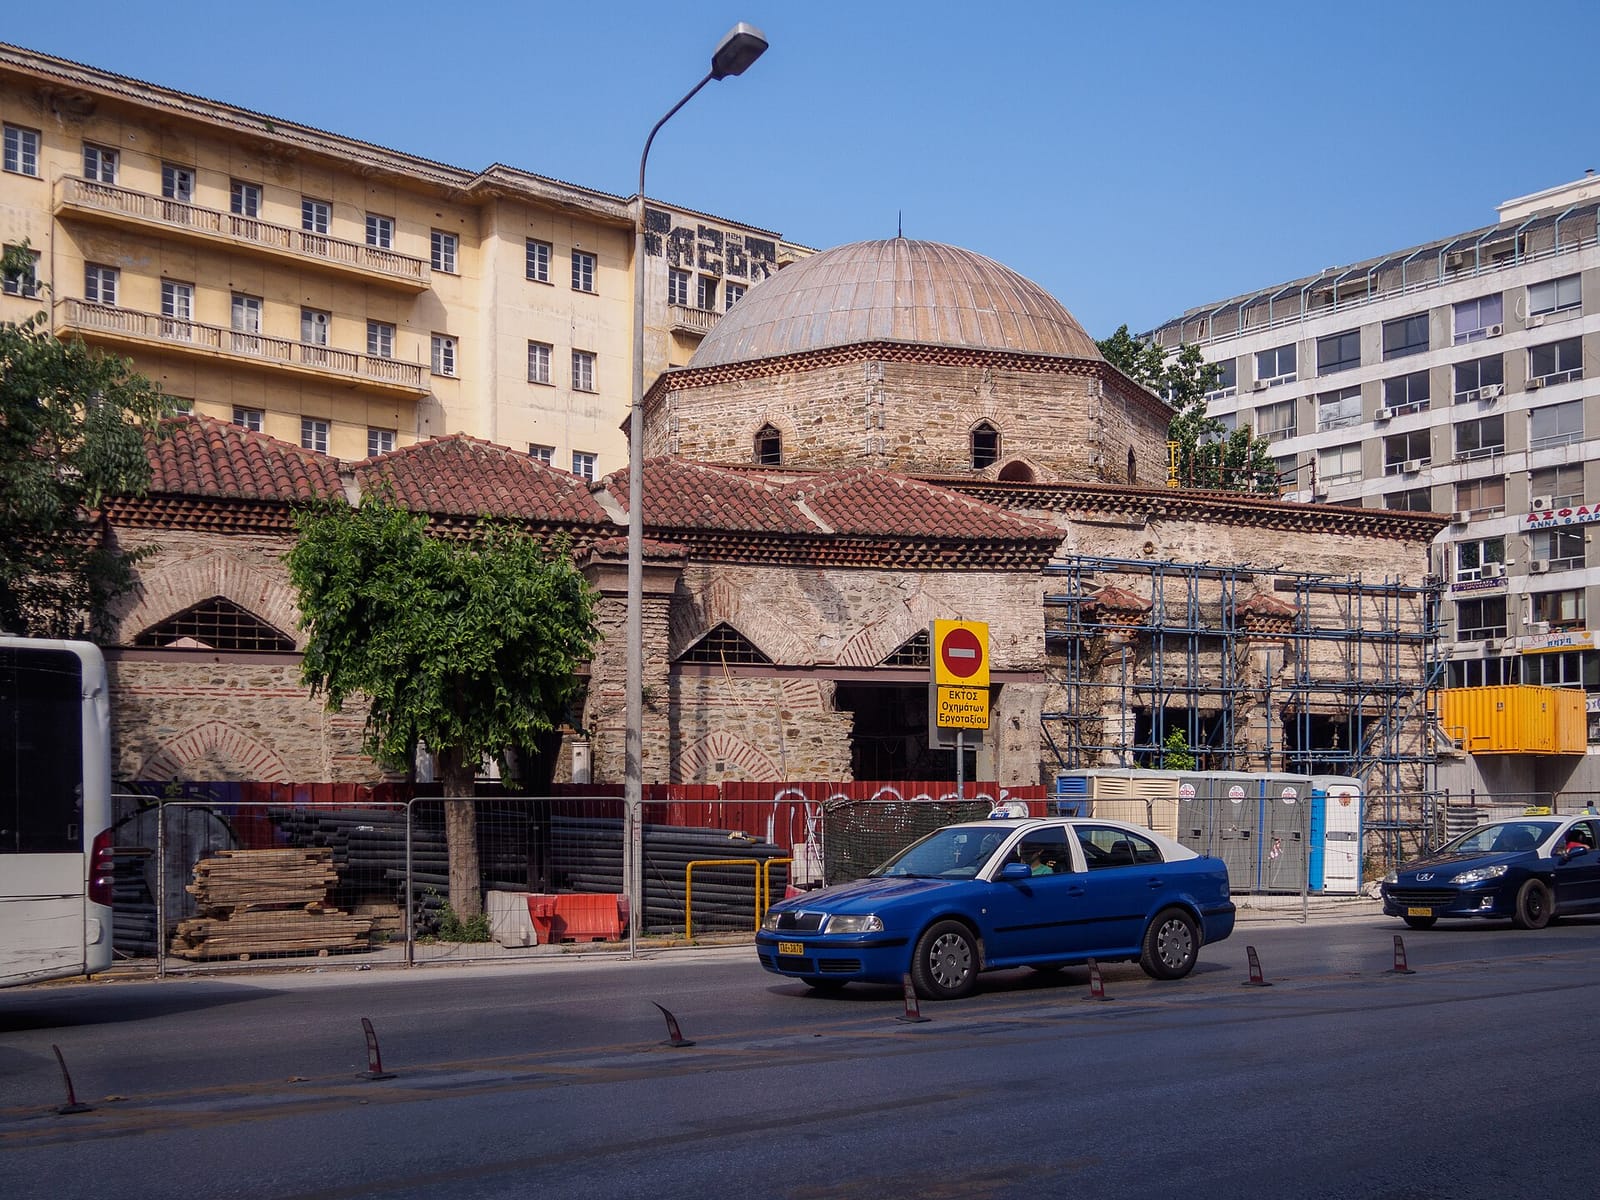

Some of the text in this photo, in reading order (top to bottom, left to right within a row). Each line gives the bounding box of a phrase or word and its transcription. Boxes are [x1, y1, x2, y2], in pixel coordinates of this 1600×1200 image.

[949, 690, 978, 701] ΕΚΤΟΣ
[942, 701, 984, 713] Οχημάτων
[940, 713, 987, 725] Εργοταξίου
